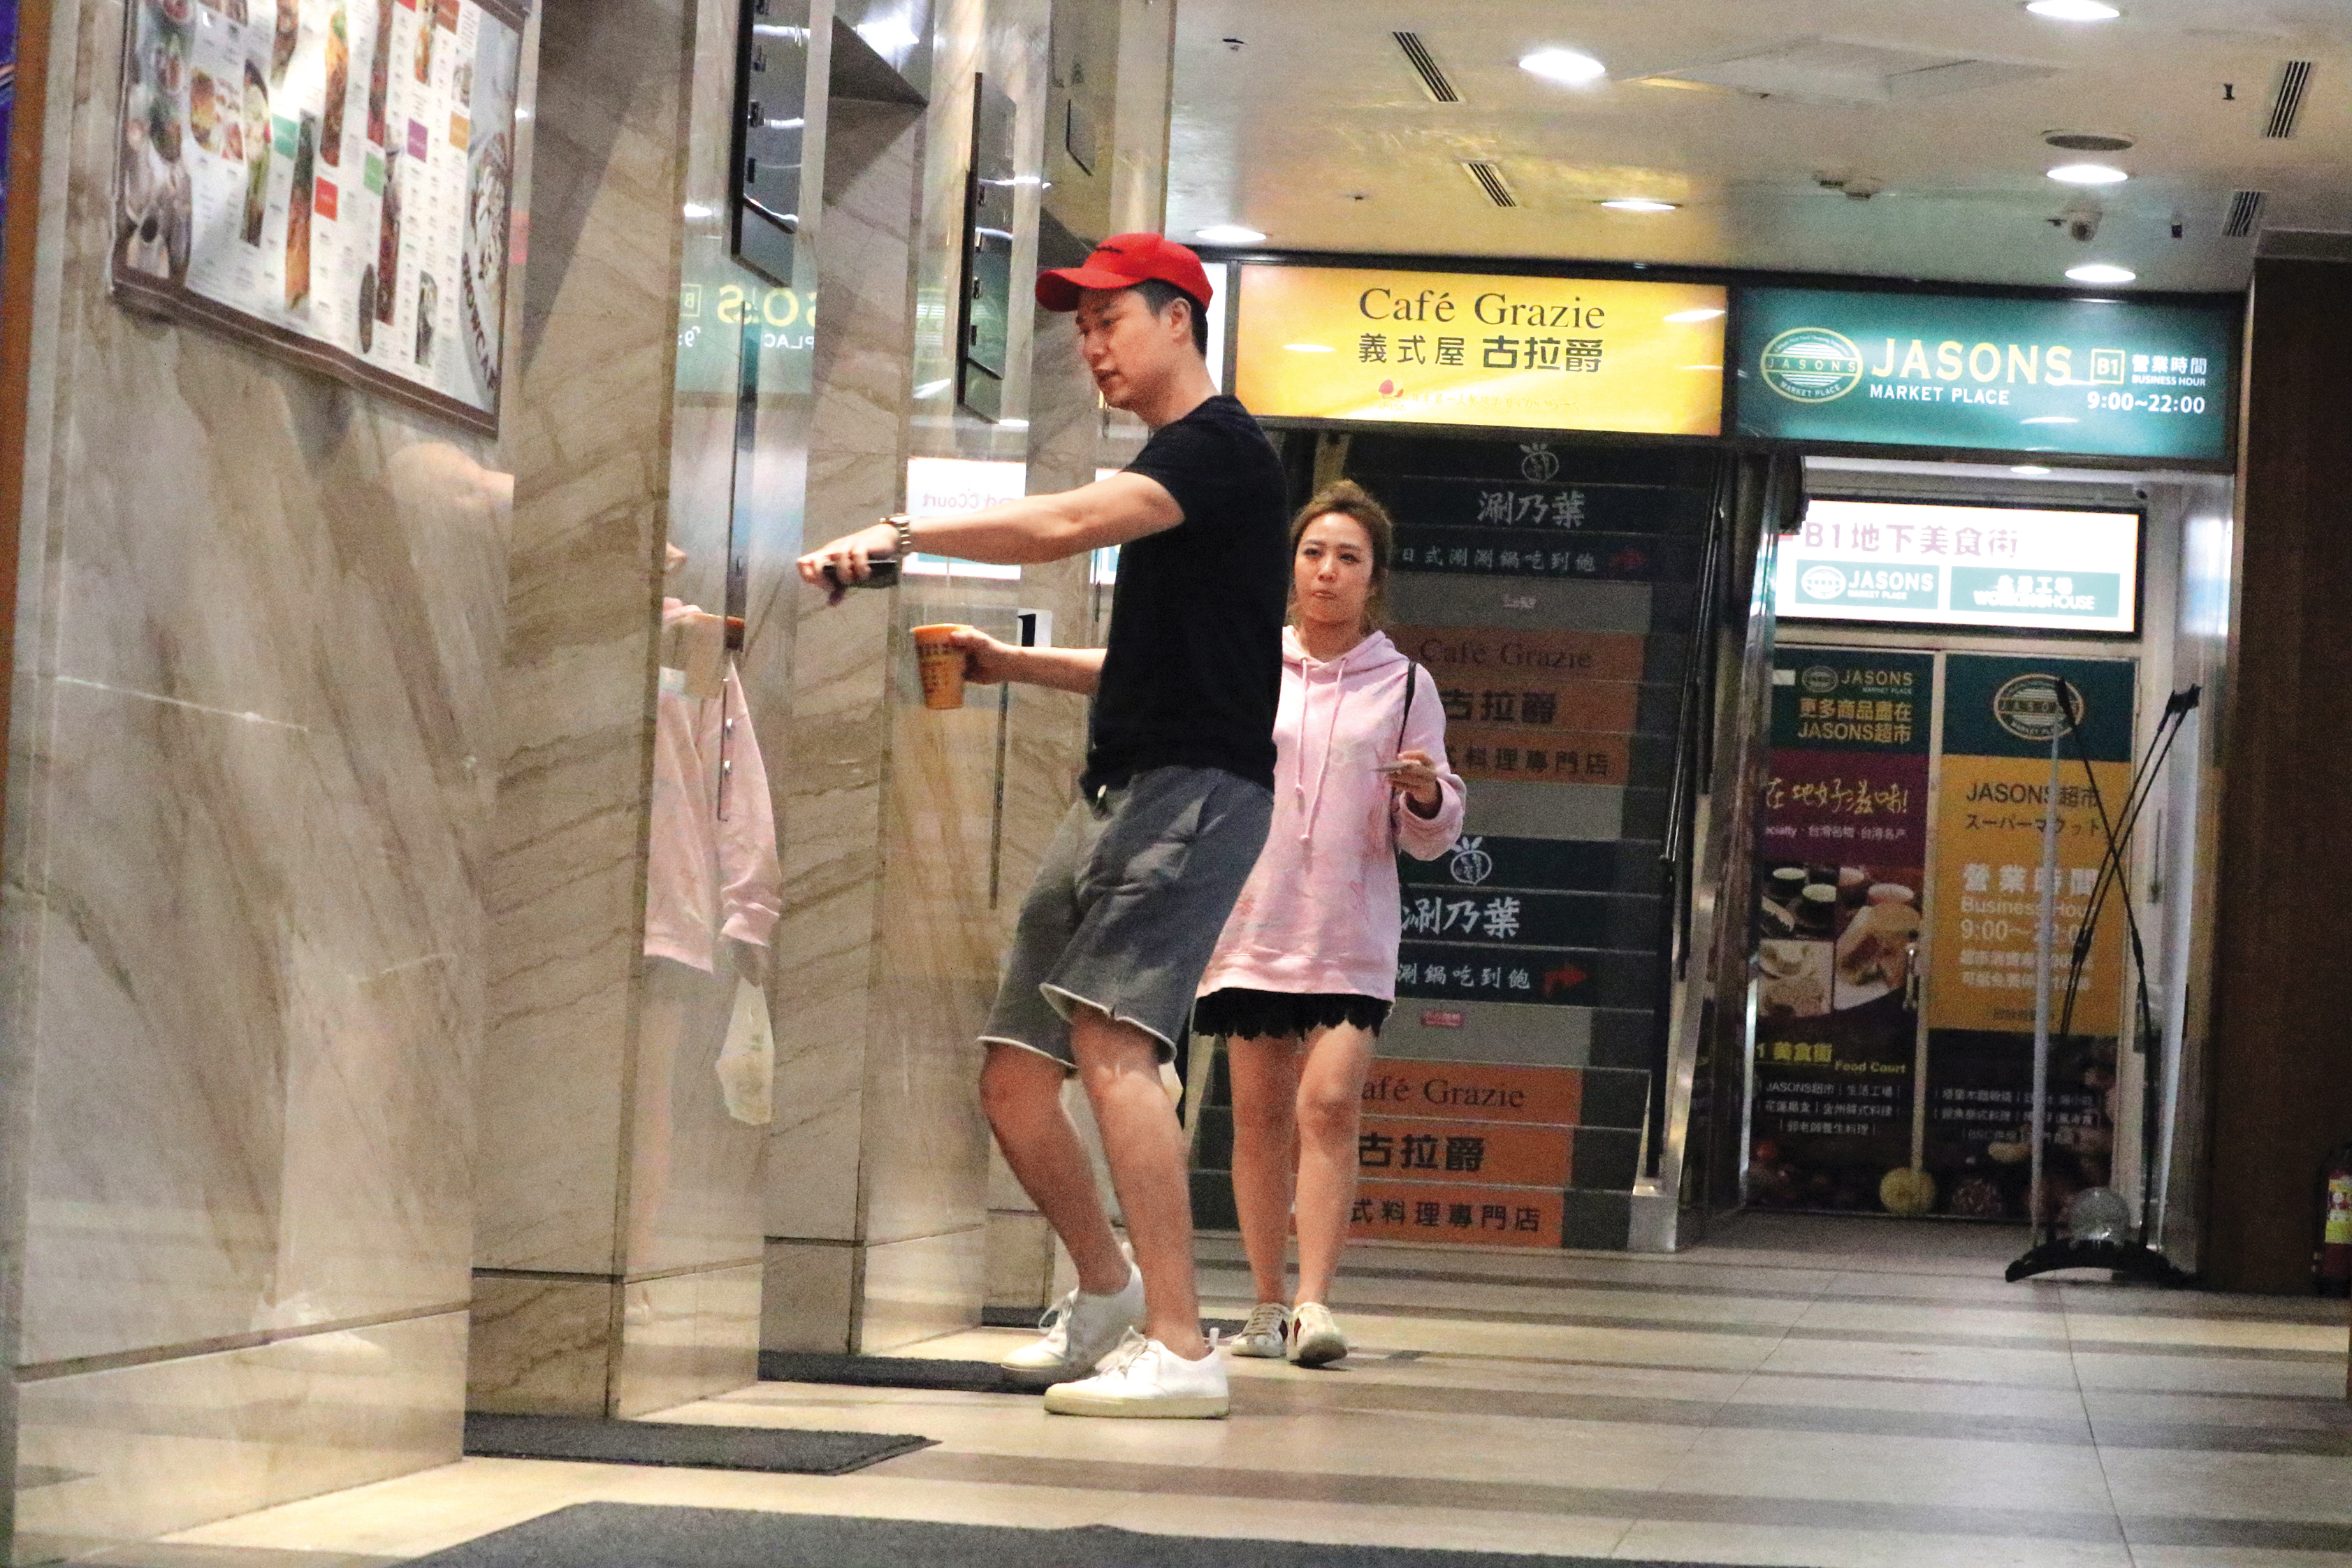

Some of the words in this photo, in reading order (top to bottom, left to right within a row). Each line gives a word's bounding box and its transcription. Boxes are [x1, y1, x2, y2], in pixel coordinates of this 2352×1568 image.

[1358, 287, 1456, 324] Café
[1474, 293, 1606, 330] Grazie
[1358, 332, 1465, 367] 義式屋
[1483, 335, 1604, 373] 古拉爵
[1871, 338, 2072, 386] JASONS
[1768, 358, 1857, 372] JASONS
[2096, 357, 2119, 376] B1
[2132, 354, 2207, 375] 營業時間
[1781, 381, 1812, 398] MARKET
[1815, 384, 1841, 397] PLACE
[2132, 375, 2177, 385] BUSINESS
[2178, 377, 2207, 387] HOUR
[1870, 384, 1943, 402] MARKET
[1952, 388, 2010, 405] PLACE
[2087, 391, 2205, 414] 9:00~22:00
[1476, 491, 1586, 528] 涮乃葉
[1848, 570, 1934, 592] JASONS
[1419, 637, 1487, 665] Café
[1500, 642, 1593, 669] Grazie
[1841, 669, 1913, 686] JASONS
[1400, 896, 1521, 940] 涮乃葉
[1834, 1059, 1867, 1073] Food
[1871, 1060, 1906, 1074] Court
[1360, 1075, 1411, 1102] afé
[1423, 1078, 1526, 1109] Grazie
[1358, 1132, 1486, 1173] 古拉爵
